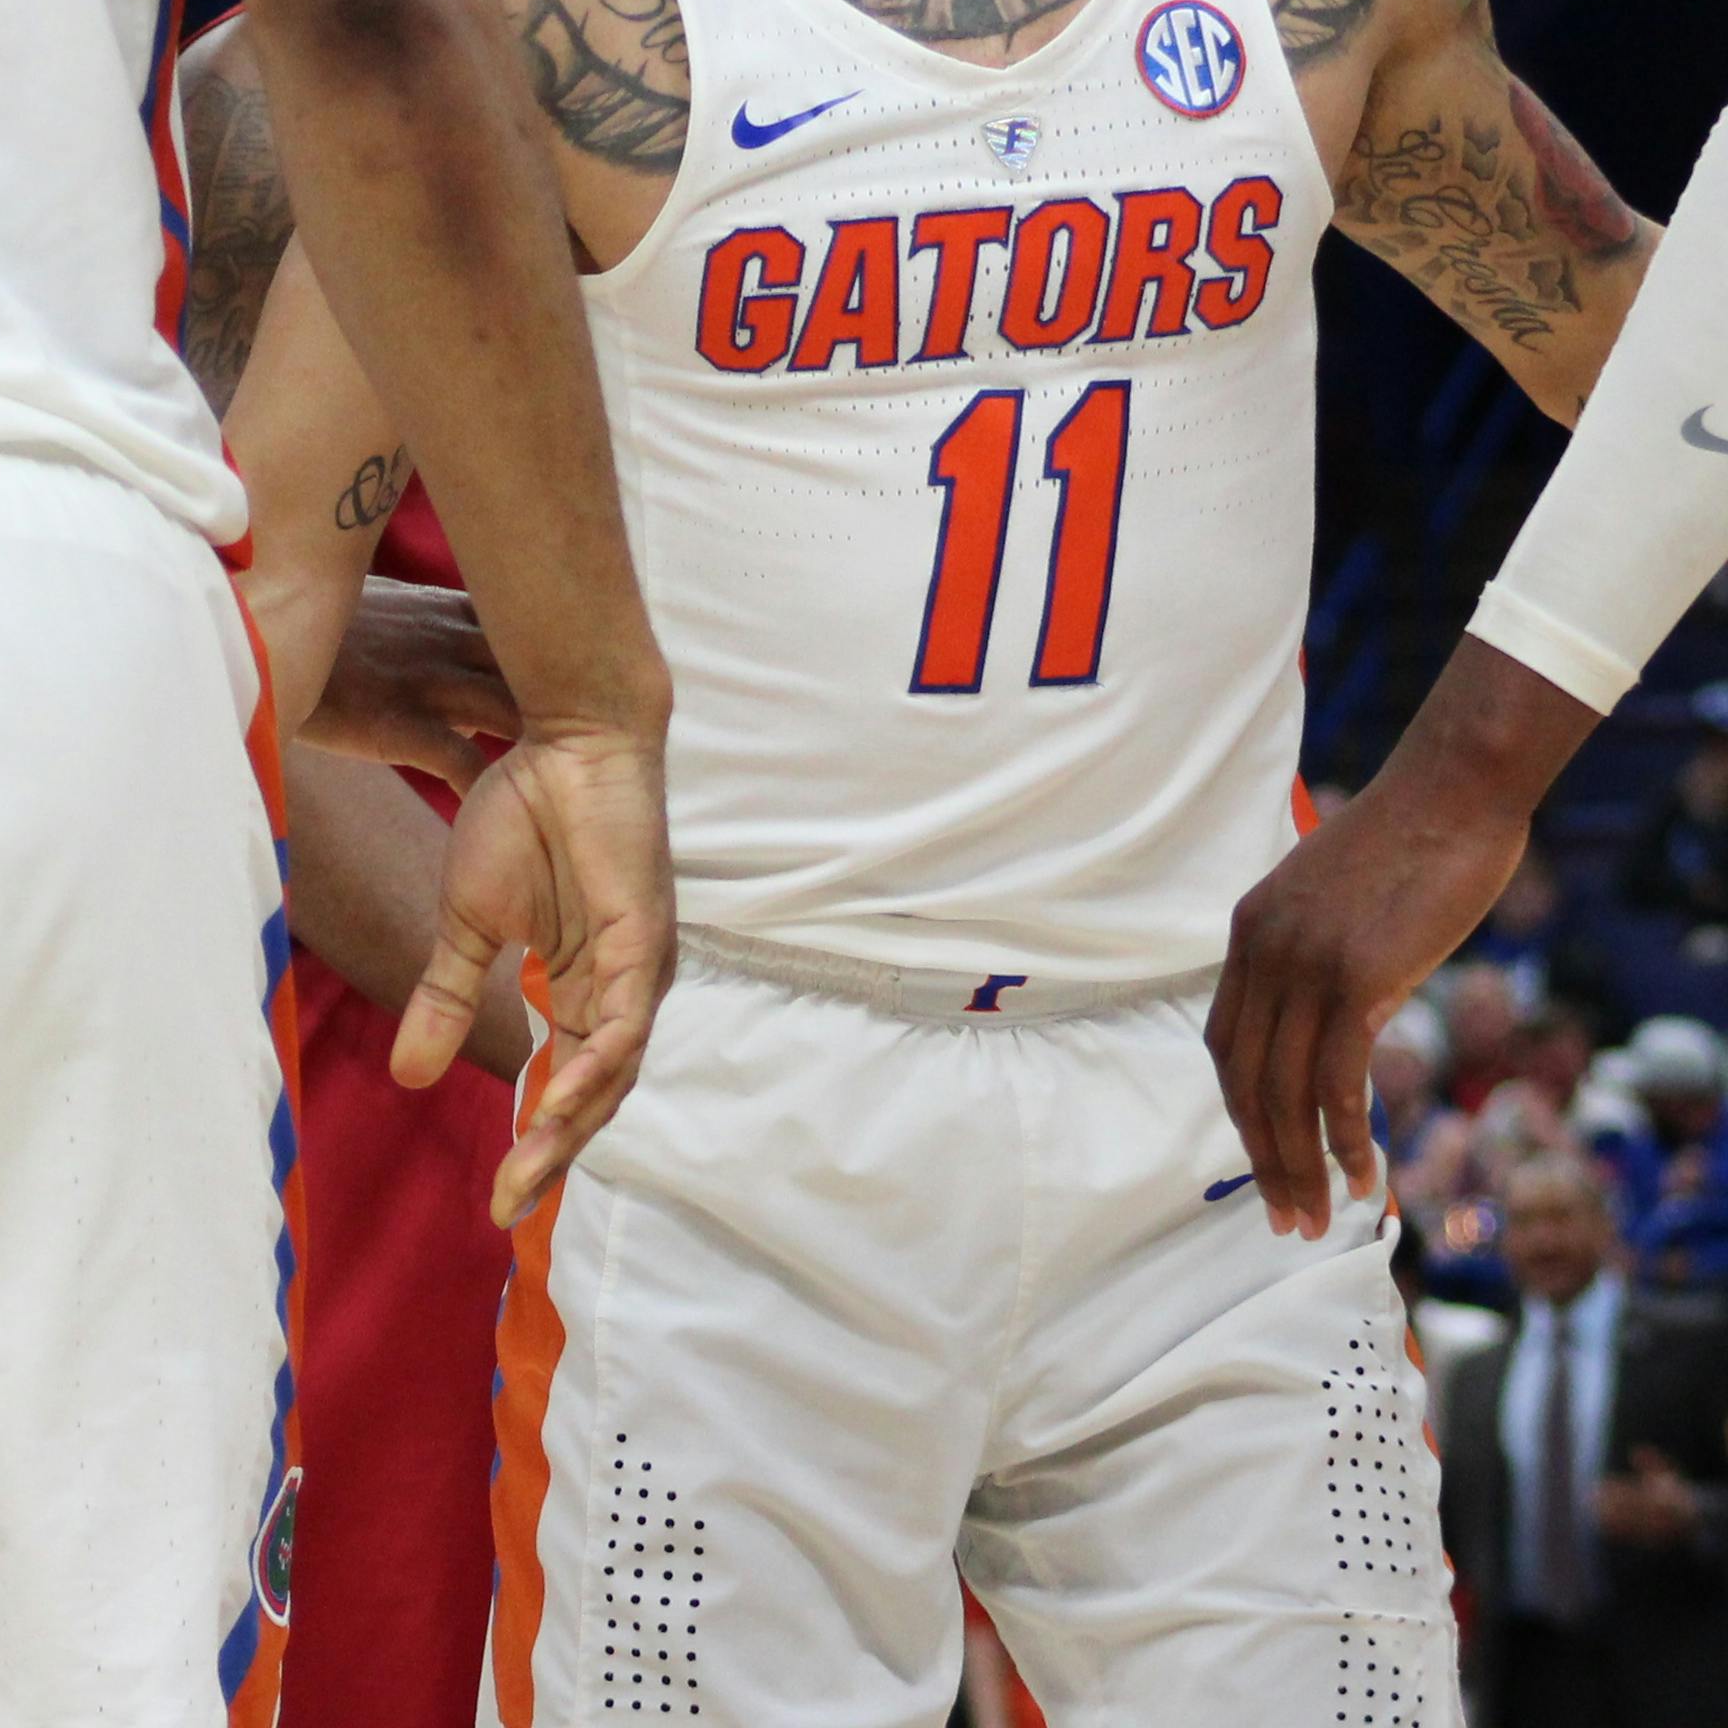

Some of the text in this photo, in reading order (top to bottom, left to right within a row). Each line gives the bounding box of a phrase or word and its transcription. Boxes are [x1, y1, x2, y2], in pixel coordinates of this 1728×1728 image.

[1145, 7, 1237, 108] SEC
[695, 175, 1283, 374] GATORS
[909, 380, 1132, 694] 11
